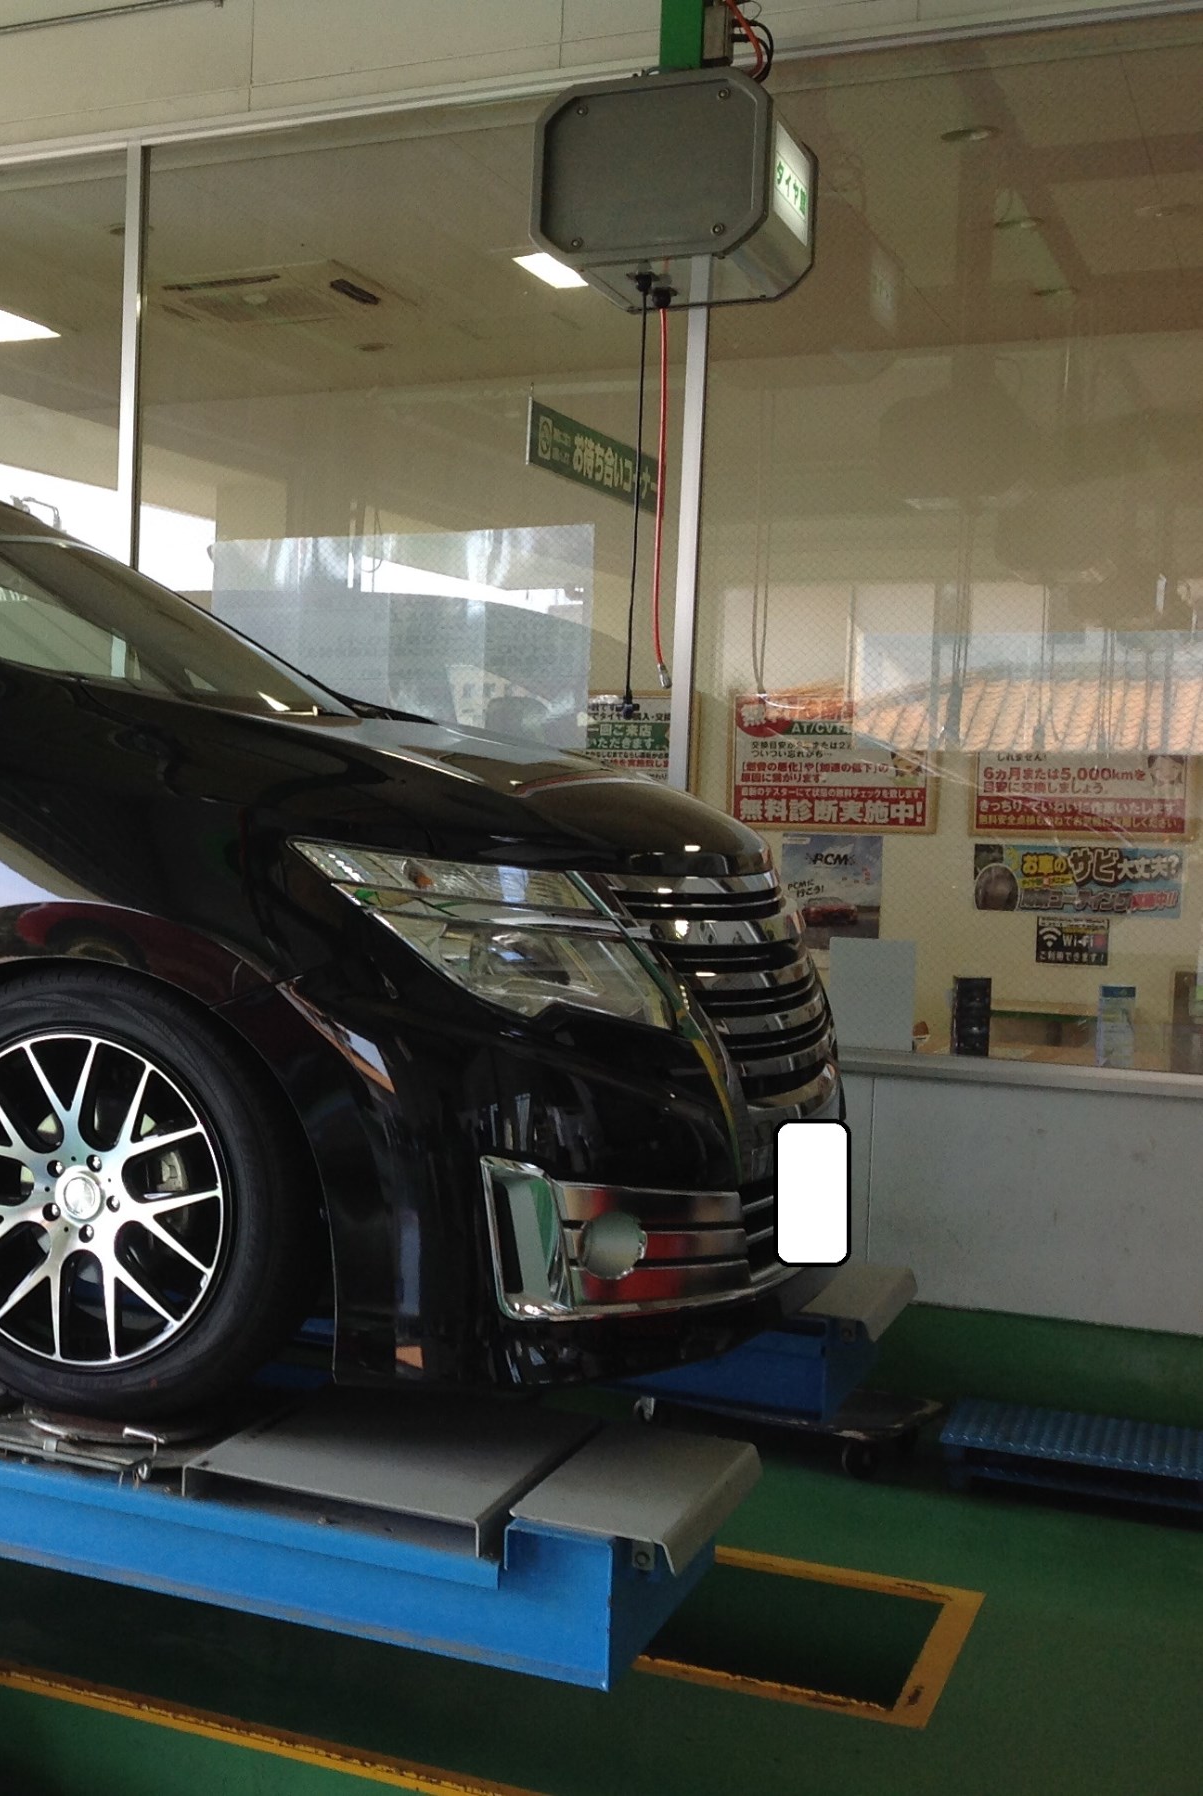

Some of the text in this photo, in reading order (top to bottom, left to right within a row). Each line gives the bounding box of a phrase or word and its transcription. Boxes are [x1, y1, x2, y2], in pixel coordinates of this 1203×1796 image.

[739, 798, 924, 825] 無料診断実施中!
